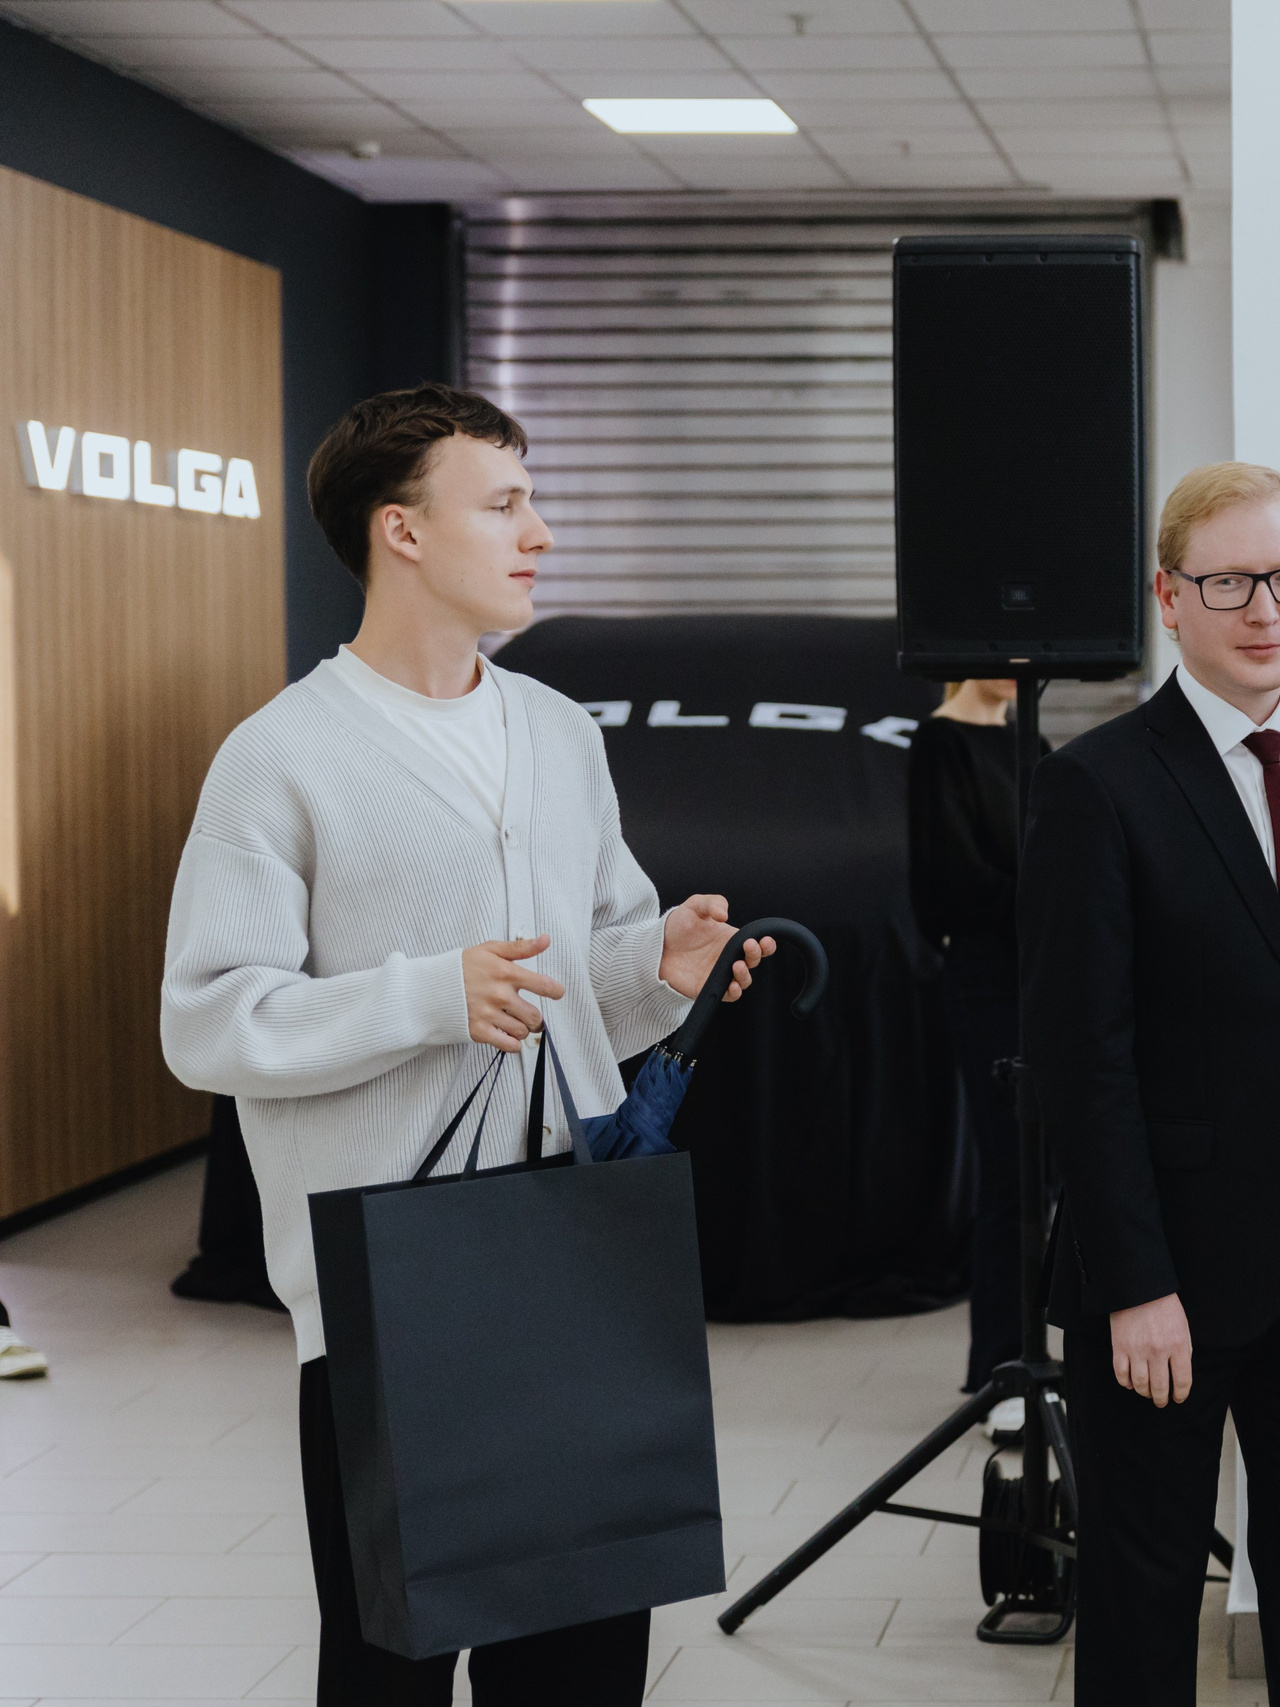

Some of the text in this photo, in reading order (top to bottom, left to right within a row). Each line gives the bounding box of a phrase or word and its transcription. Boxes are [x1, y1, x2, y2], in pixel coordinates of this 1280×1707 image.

[25, 419, 261, 519] VOLGA
[1012, 590, 1029, 601] JBL
[579, 700, 919, 750] OLGA
